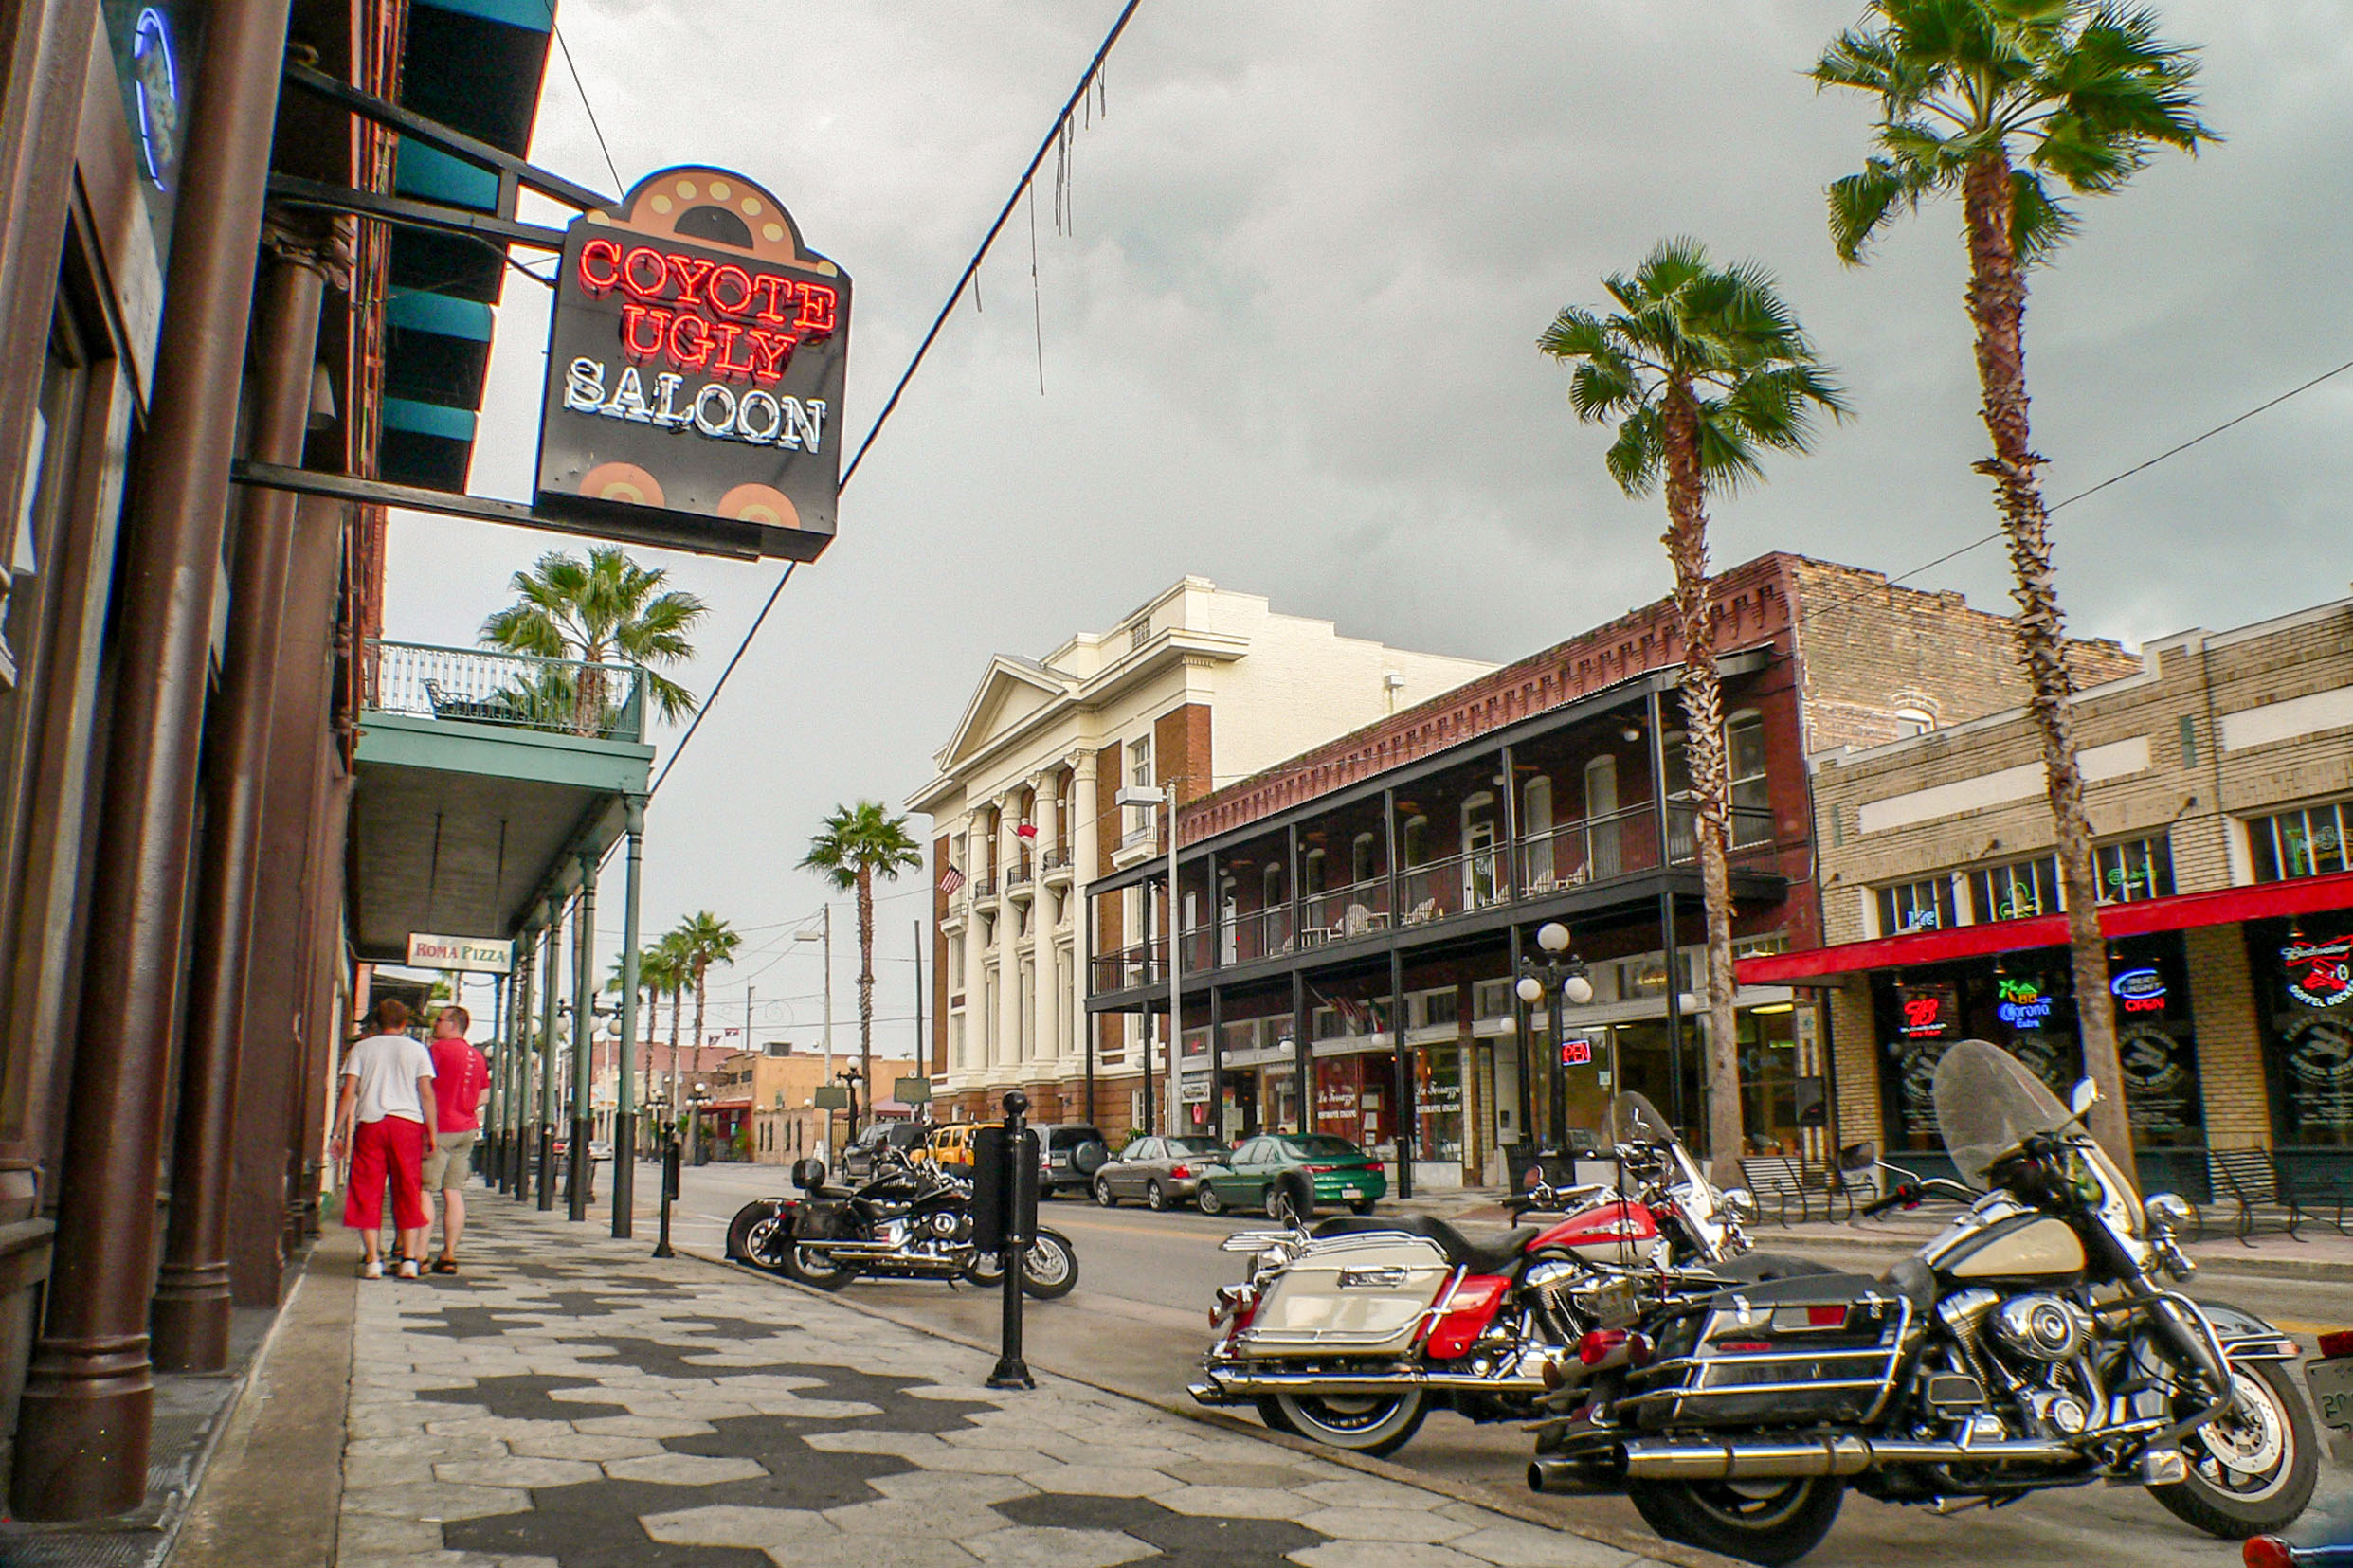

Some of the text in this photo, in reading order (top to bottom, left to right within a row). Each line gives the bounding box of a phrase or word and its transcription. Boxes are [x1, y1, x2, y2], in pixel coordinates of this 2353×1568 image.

[578, 237, 838, 332] COYOTE
[621, 303, 799, 382] UGLY
[564, 356, 828, 455] SALOON
[416, 942, 505, 963] ROMA PIZZA
[1998, 1002, 2050, 1021] Corona
[2124, 998, 2165, 1012] OPEN
[1562, 1043, 1590, 1062] PEN
